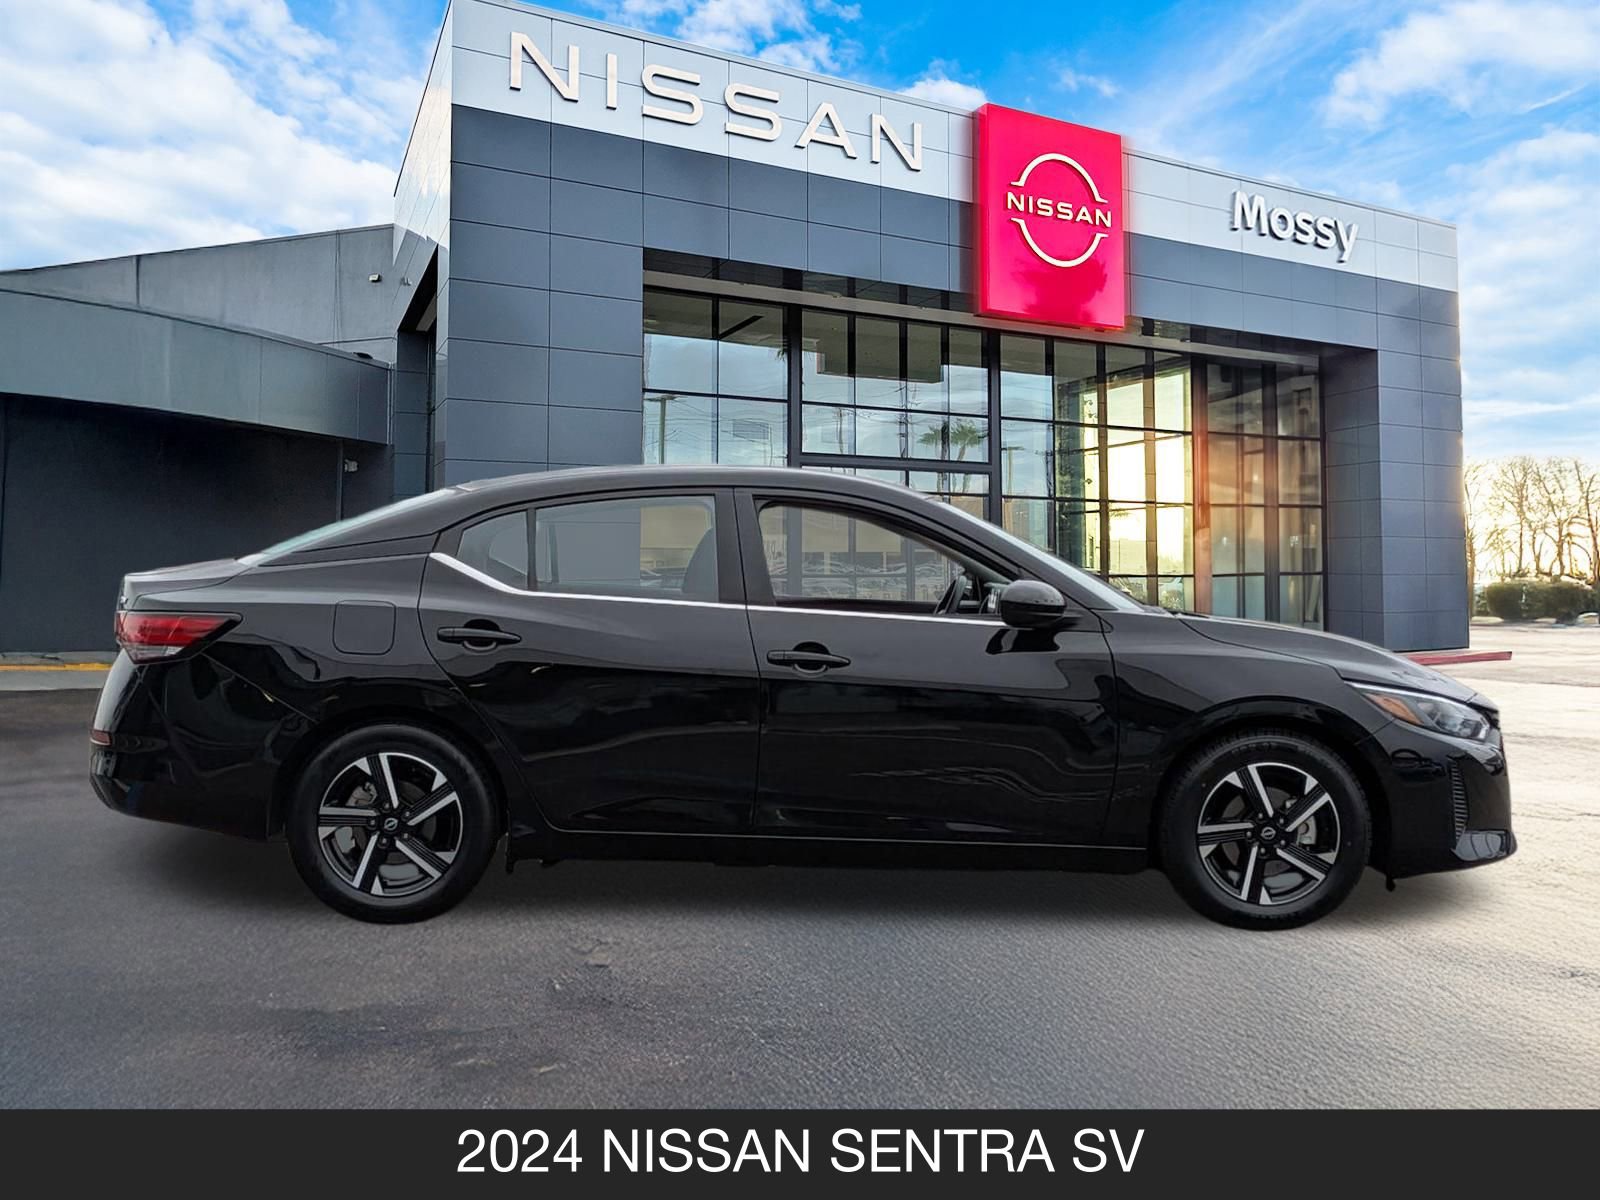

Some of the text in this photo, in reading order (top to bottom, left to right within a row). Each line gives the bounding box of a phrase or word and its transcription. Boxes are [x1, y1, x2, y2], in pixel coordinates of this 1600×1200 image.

[509, 31, 923, 171] NISSAN
[1007, 191, 1112, 228] NISSAN
[1231, 190, 1359, 262] Mossy
